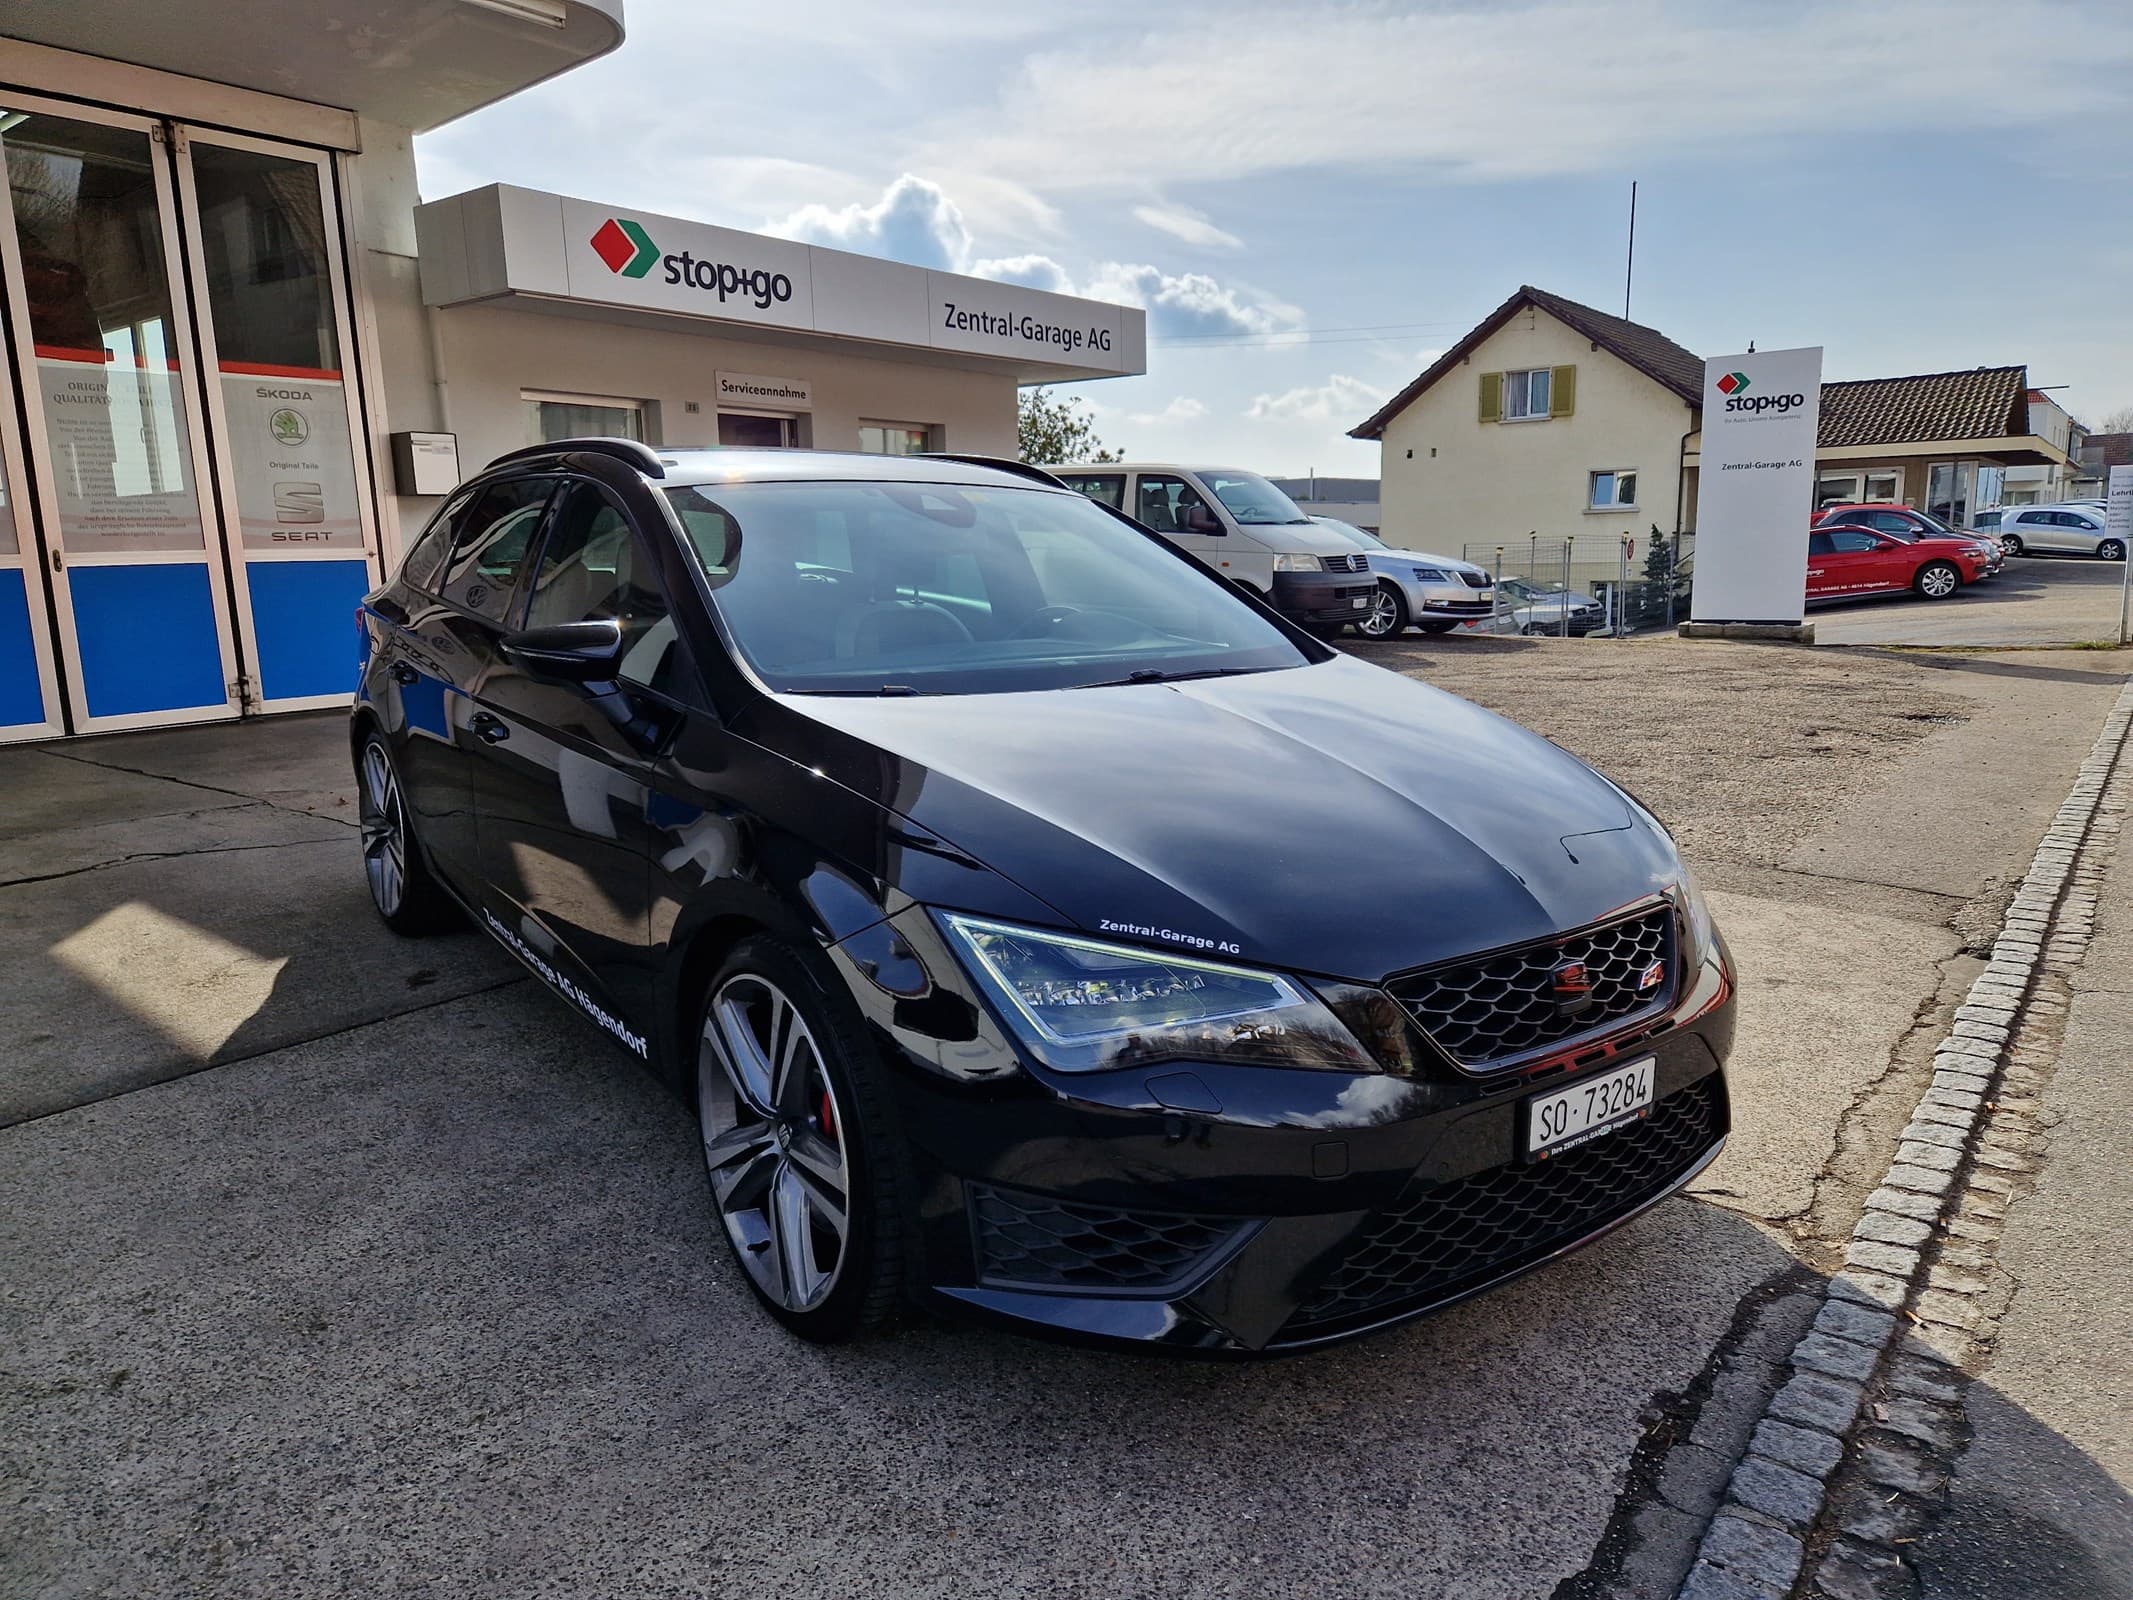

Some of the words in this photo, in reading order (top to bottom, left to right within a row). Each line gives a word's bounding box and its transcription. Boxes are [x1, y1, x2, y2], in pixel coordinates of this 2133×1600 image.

[663, 251, 792, 309] stop+go
[944, 303, 1082, 352] Zentral-Garage
[1087, 327, 1111, 351] AG
[256, 387, 313, 401] ŠKODA
[721, 379, 807, 400] Serviceannahme
[1726, 393, 1804, 414] stop+go
[269, 461, 300, 471] Original
[1721, 461, 1787, 471] Zentral-Garage
[1789, 460, 1802, 468] AG
[271, 532, 333, 542] SEAT
[1100, 919, 1215, 949] Zentral-Garage
[1218, 941, 1240, 954] AG
[556, 971, 576, 999] AG
[575, 986, 648, 1059] Hägendorf
